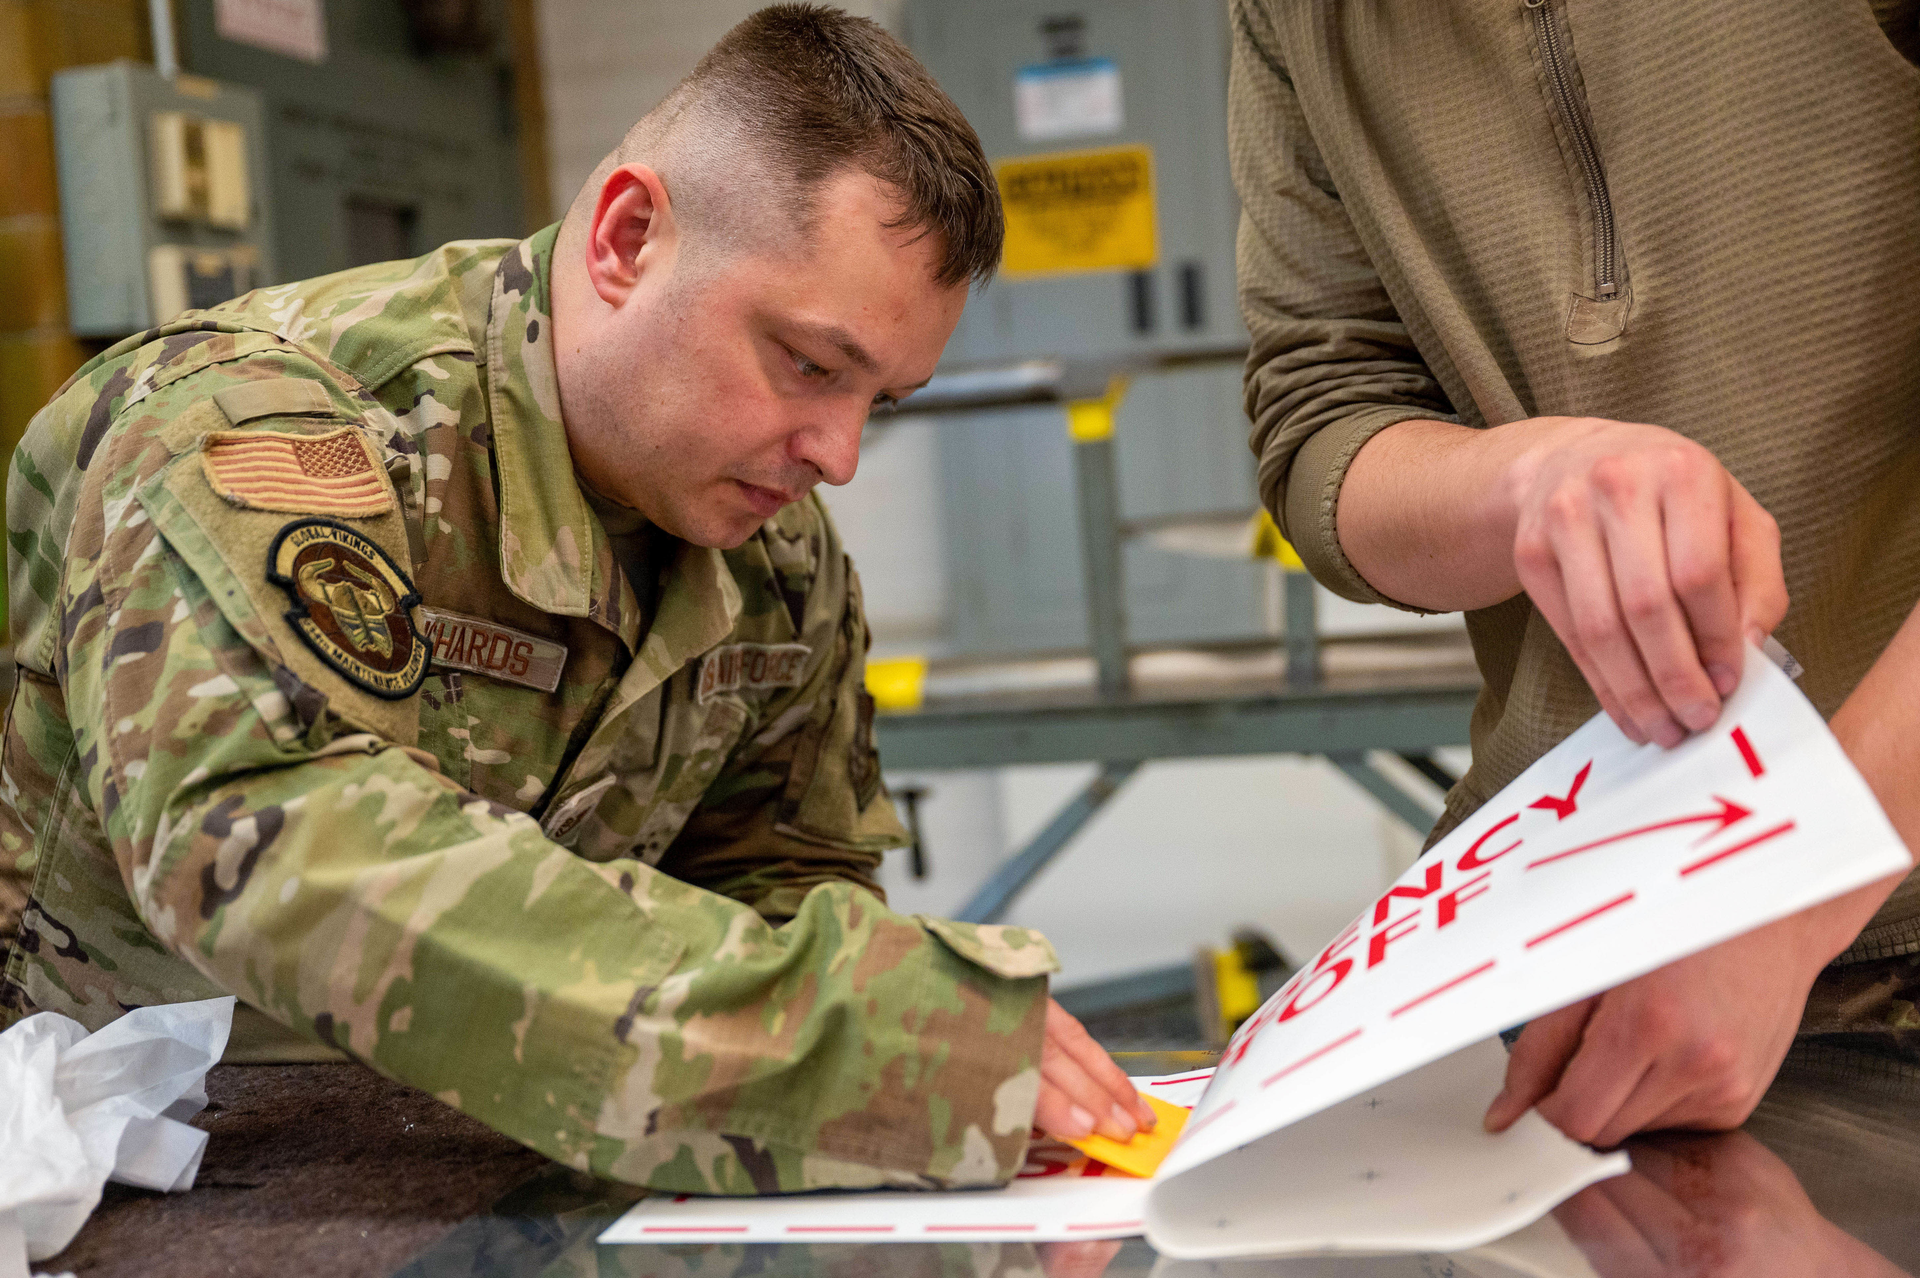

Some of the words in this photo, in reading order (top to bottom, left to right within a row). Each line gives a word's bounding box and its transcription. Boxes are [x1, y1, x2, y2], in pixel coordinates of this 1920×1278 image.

[290, 526, 328, 547] GLOBAL
[331, 527, 375, 560] VIKINGS
[333, 649, 399, 689] MAINTENANCE
